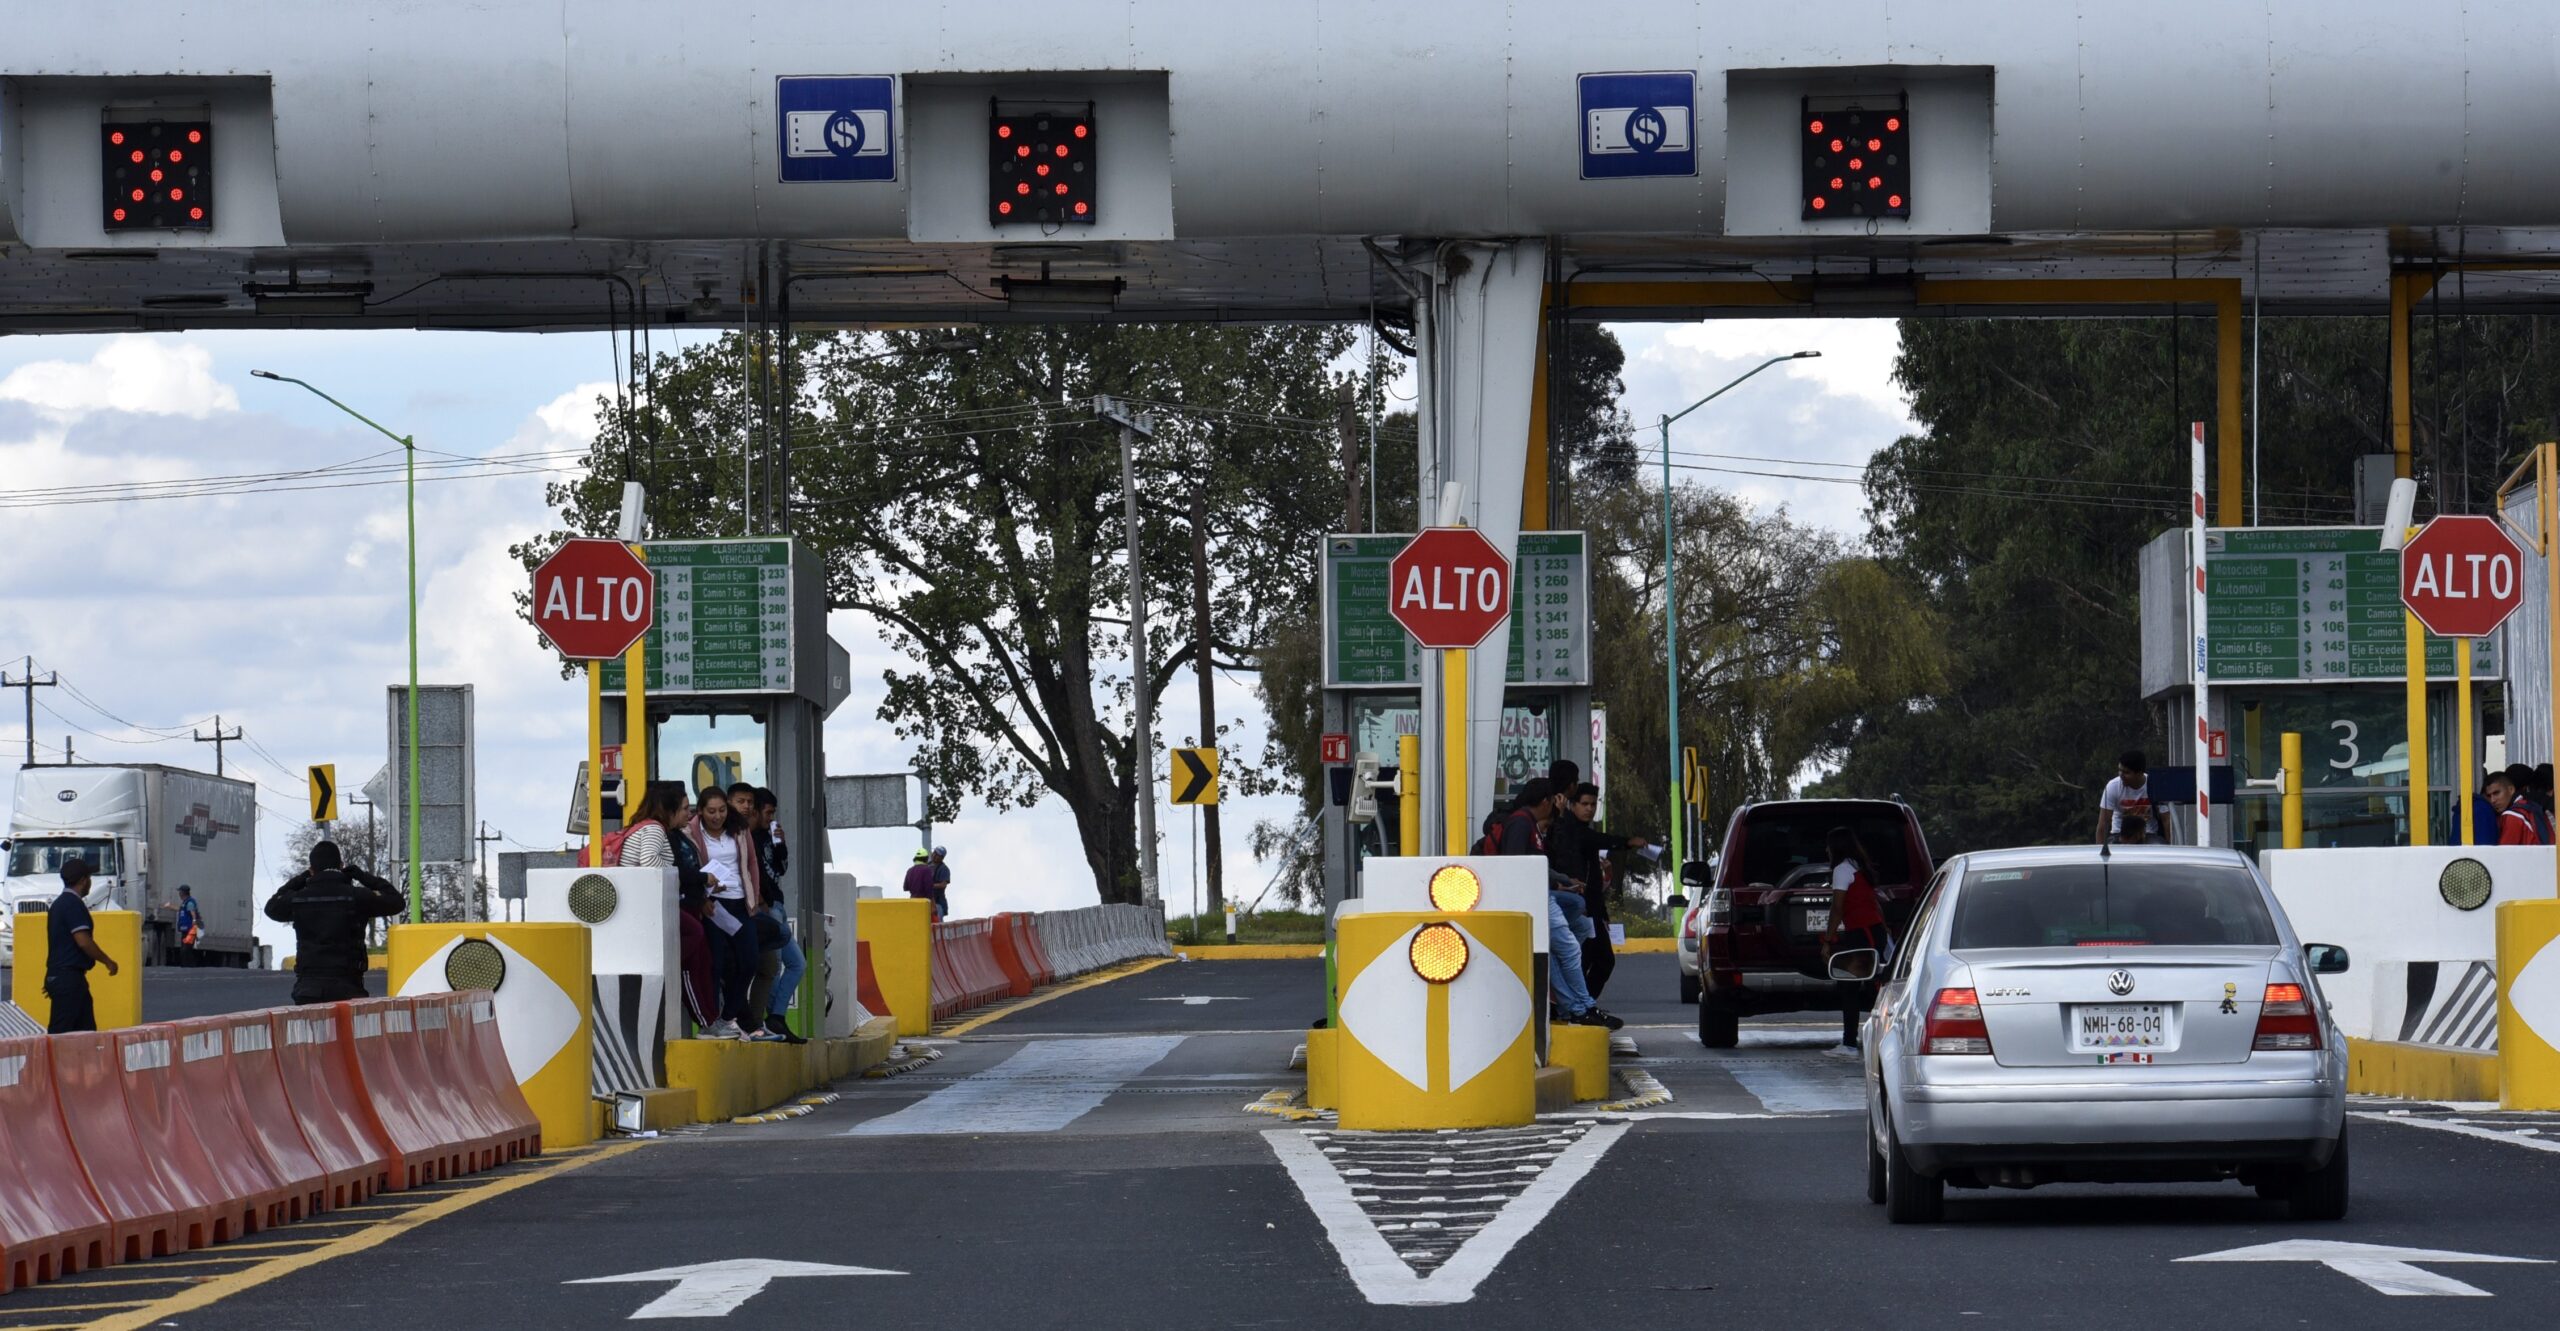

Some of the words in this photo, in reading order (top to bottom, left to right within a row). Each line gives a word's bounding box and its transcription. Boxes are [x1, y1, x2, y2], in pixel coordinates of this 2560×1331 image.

[719, 554, 764, 565] VEHICULAR
[1545, 559, 1568, 570] 233
[2328, 560, 2343, 571] 21
[677, 573, 689, 583] 21
[768, 569, 785, 579] 233
[2411, 553, 2513, 600] ALTO
[1545, 576, 1568, 587] 260
[2328, 578, 2344, 590] 43
[769, 586, 785, 597] 260
[1400, 565, 1501, 612] ALTO
[542, 575, 644, 622] ALTO
[677, 591, 689, 601] 43
[1545, 593, 1568, 604] 289
[769, 604, 786, 615] 289
[2329, 601, 2344, 612] 61
[678, 612, 689, 622] 61
[1546, 611, 1568, 622] 341
[769, 621, 786, 631] 341
[2322, 621, 2345, 633] 106
[672, 632, 689, 642] 106
[1546, 629, 1569, 640] 385
[769, 638, 787, 649] 385
[2248, 642, 2253, 653] 4
[2255, 641, 2272, 656] Ejes
[2323, 640, 2345, 652] 145
[2352, 645, 2366, 657] Eje
[2369, 644, 2407, 655] Exceden
[2477, 641, 2492, 652] 22
[673, 652, 690, 662] 145
[1554, 649, 1569, 659] 22
[2197, 636, 2206, 673] SIMEX
[775, 657, 786, 667] 22
[2351, 664, 2366, 676] Eje
[2476, 659, 2492, 670] 44
[1554, 667, 1569, 677] 44
[2249, 662, 2254, 673] 5
[2256, 662, 2274, 676] Ejes
[2323, 661, 2345, 673] 188
[673, 674, 690, 685] 188
[775, 674, 786, 684] 44
[1501, 716, 1529, 738] ZAS
[2330, 719, 2359, 769] 3
[1986, 987, 2031, 997] JETTA
[2083, 1015, 2161, 1033] NMH-68-04
